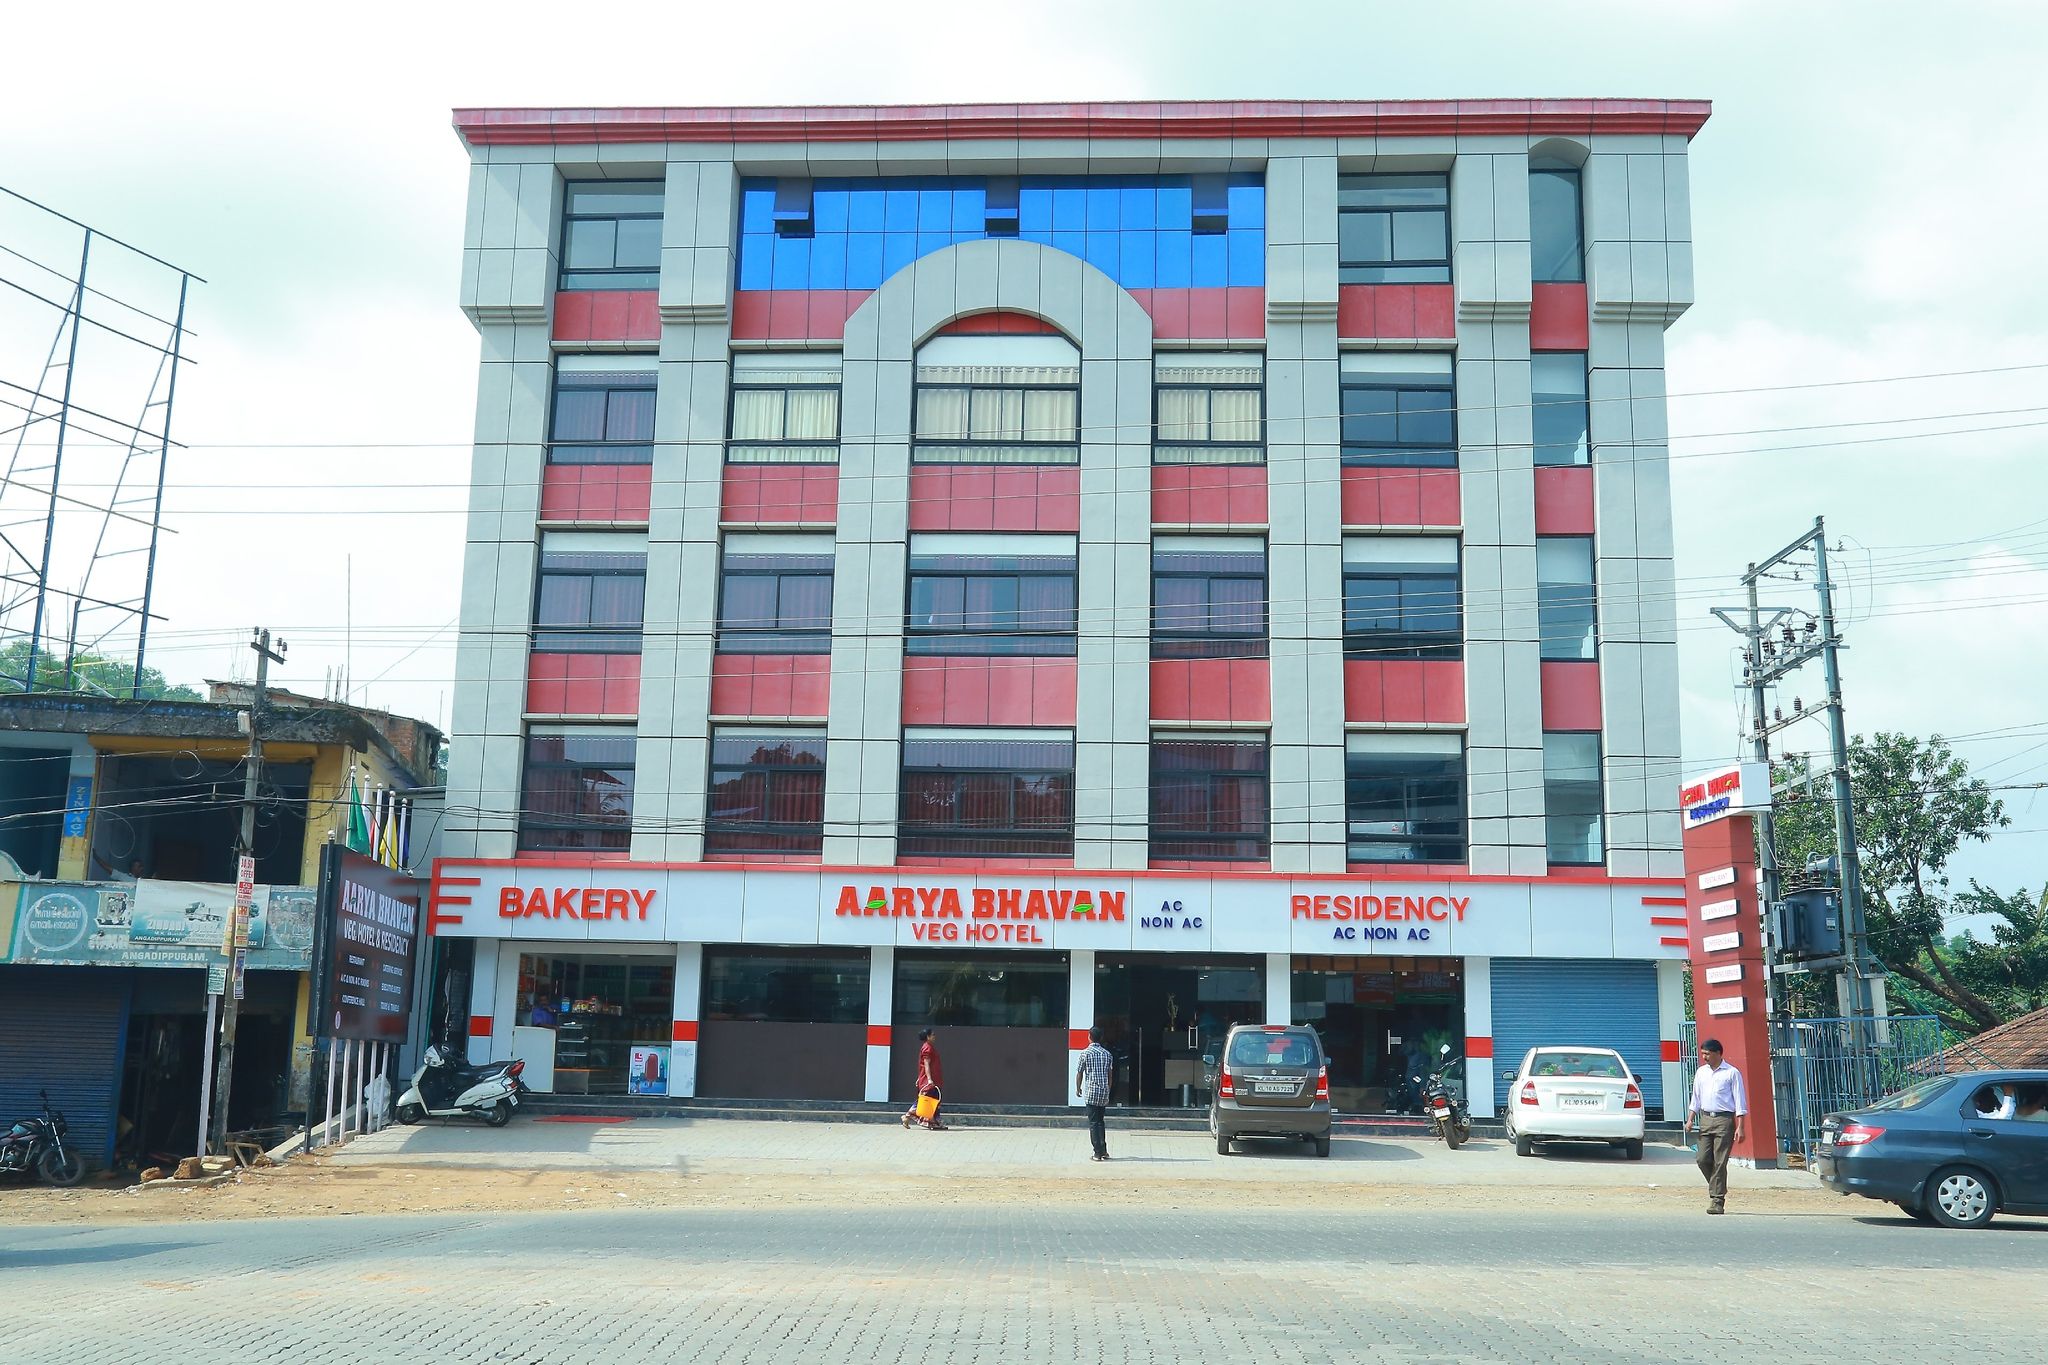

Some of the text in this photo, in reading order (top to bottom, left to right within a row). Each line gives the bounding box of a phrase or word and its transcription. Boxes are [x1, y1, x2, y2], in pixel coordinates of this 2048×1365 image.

[342, 879, 414, 934] AARYA BHAVAN
[498, 886, 657, 921] BAKERY
[835, 885, 1126, 921] AARYA BHAVAN
[1161, 900, 1183, 912] AC
[1291, 895, 1470, 921] RESIDENCY
[911, 922, 1043, 943] VEG HOTEL
[1140, 917, 1203, 929] NON AC
[1332, 927, 1430, 941] AC NON AC
[357, 923, 375, 947] HOTEL
[381, 931, 410, 956] RESIDENCY
